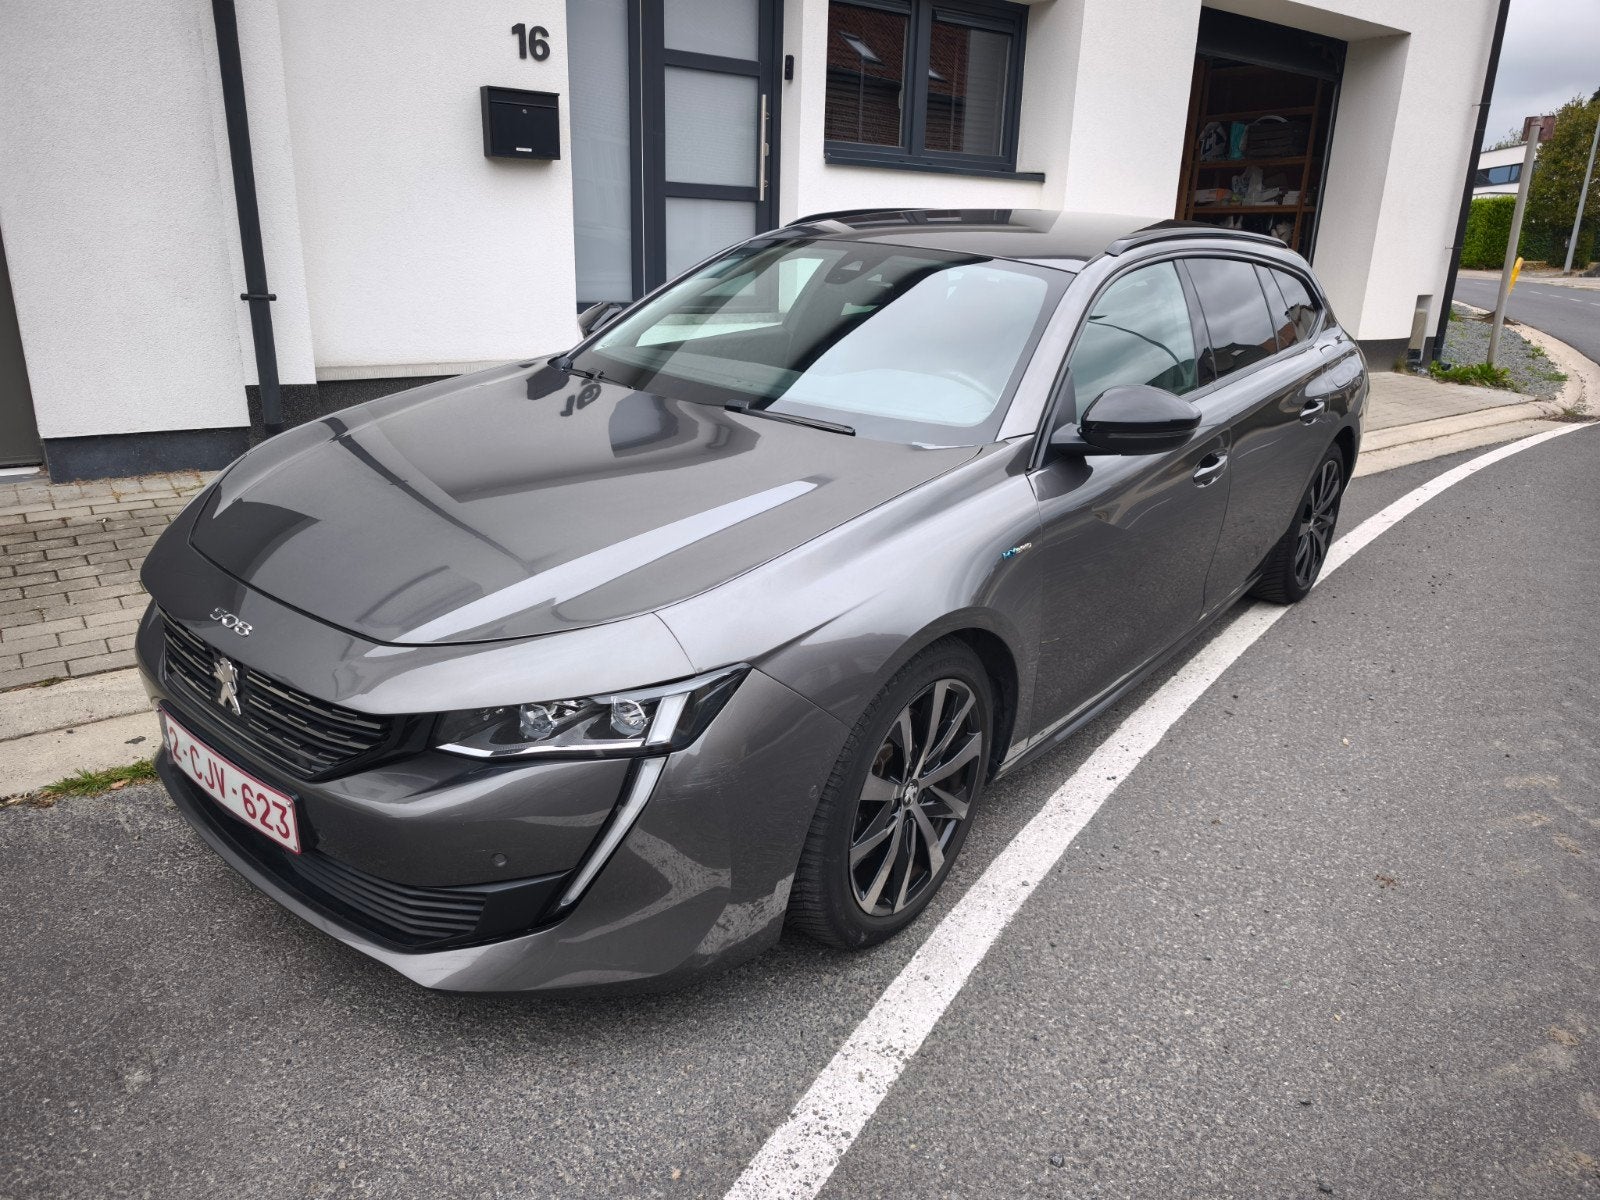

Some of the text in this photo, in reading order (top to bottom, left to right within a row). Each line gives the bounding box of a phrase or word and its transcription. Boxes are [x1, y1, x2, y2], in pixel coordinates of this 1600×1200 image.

[511, 23, 550, 62] 16
[210, 607, 253, 637] 508
[168, 726, 290, 840] 2-CJV-623
